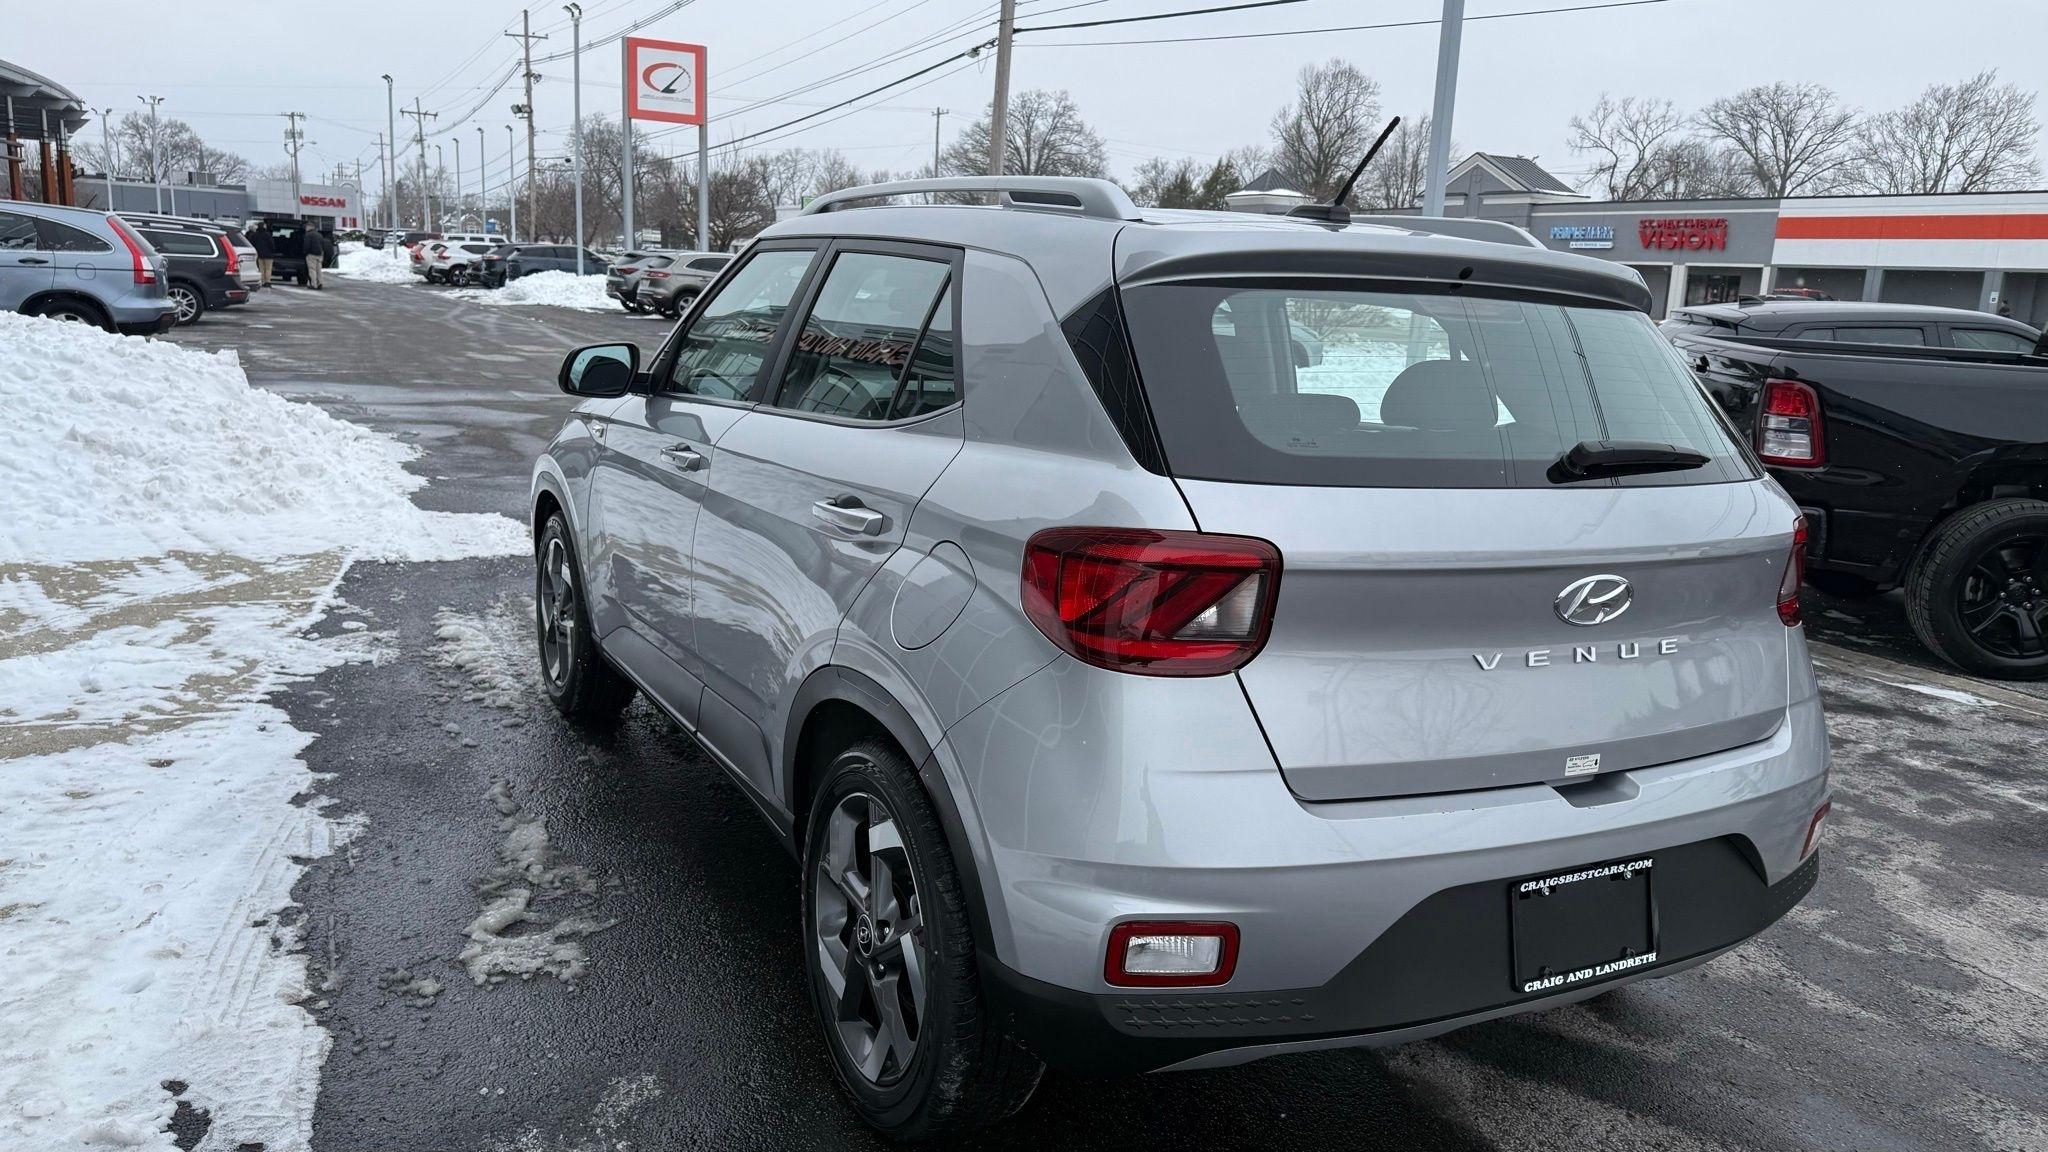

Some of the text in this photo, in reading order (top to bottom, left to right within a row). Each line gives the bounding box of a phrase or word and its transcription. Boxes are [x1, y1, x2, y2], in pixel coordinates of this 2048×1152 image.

[300, 195, 346, 208] NISSAN
[1639, 229, 1727, 252] VISION
[1472, 638, 1678, 670] VENUE
[1520, 858, 1653, 893] CRAIGSBESTCARS.COM
[1524, 952, 1657, 992] CRAIG AND LANDRETH
